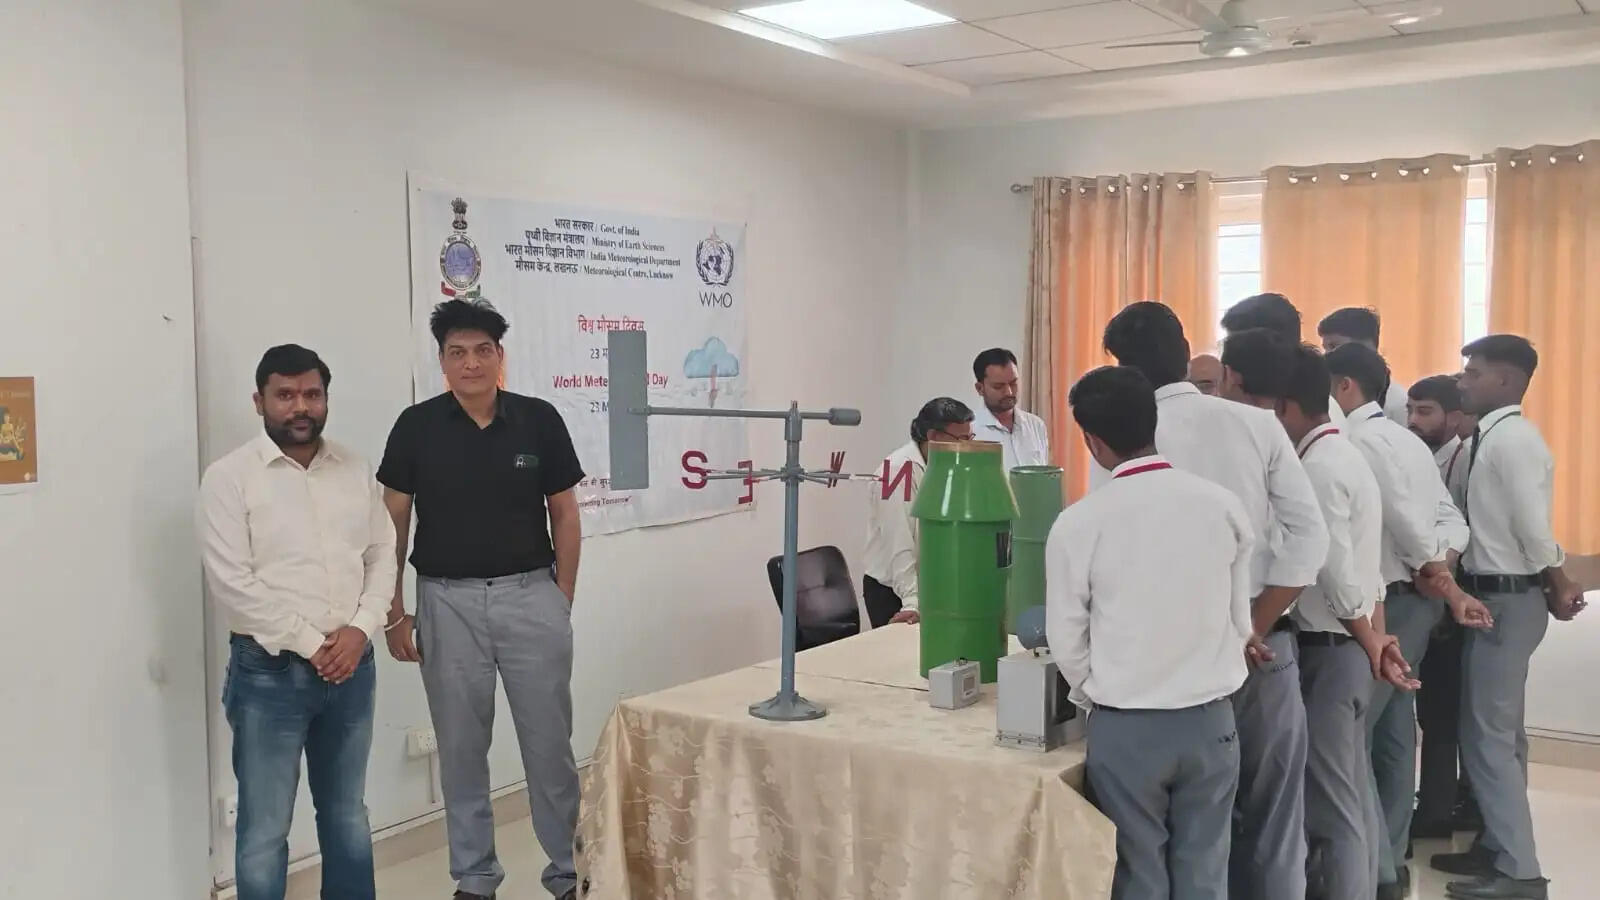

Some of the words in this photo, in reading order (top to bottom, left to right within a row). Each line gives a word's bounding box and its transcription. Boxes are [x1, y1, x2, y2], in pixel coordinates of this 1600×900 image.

[554, 218, 571, 229] भारत
[572, 220, 594, 232] सरकार
[600, 223, 616, 234] Govt.
[618, 226, 624, 235] of
[625, 226, 640, 236] India
[525, 227, 541, 241] पृथ्वी
[542, 228, 561, 243] विज्ञान
[562, 232, 585, 245] मंत्रालय
[592, 236, 616, 250] Ministry
[618, 239, 624, 249] of
[625, 240, 641, 251] Earth
[642, 240, 665, 252] Sciences
[505, 244, 523, 256] भारत
[524, 240, 544, 257] मौसम
[545, 244, 565, 259] विज्ञान
[566, 245, 585, 259] विभाग
[590, 251, 607, 261] India
[608, 252, 649, 265] Meteorological
[650, 255, 681, 267] Department
[515, 256, 536, 272] मौसम
[554, 262, 579, 273] लखनऊ
[584, 265, 627, 277] Meteorological
[649, 269, 673, 279] Lucknow
[699, 291, 733, 308] WMO
[590, 348, 600, 360] 23
[552, 374, 582, 389] World
[652, 373, 669, 389] Day
[590, 401, 600, 413] 23
[682, 450, 709, 490] S
